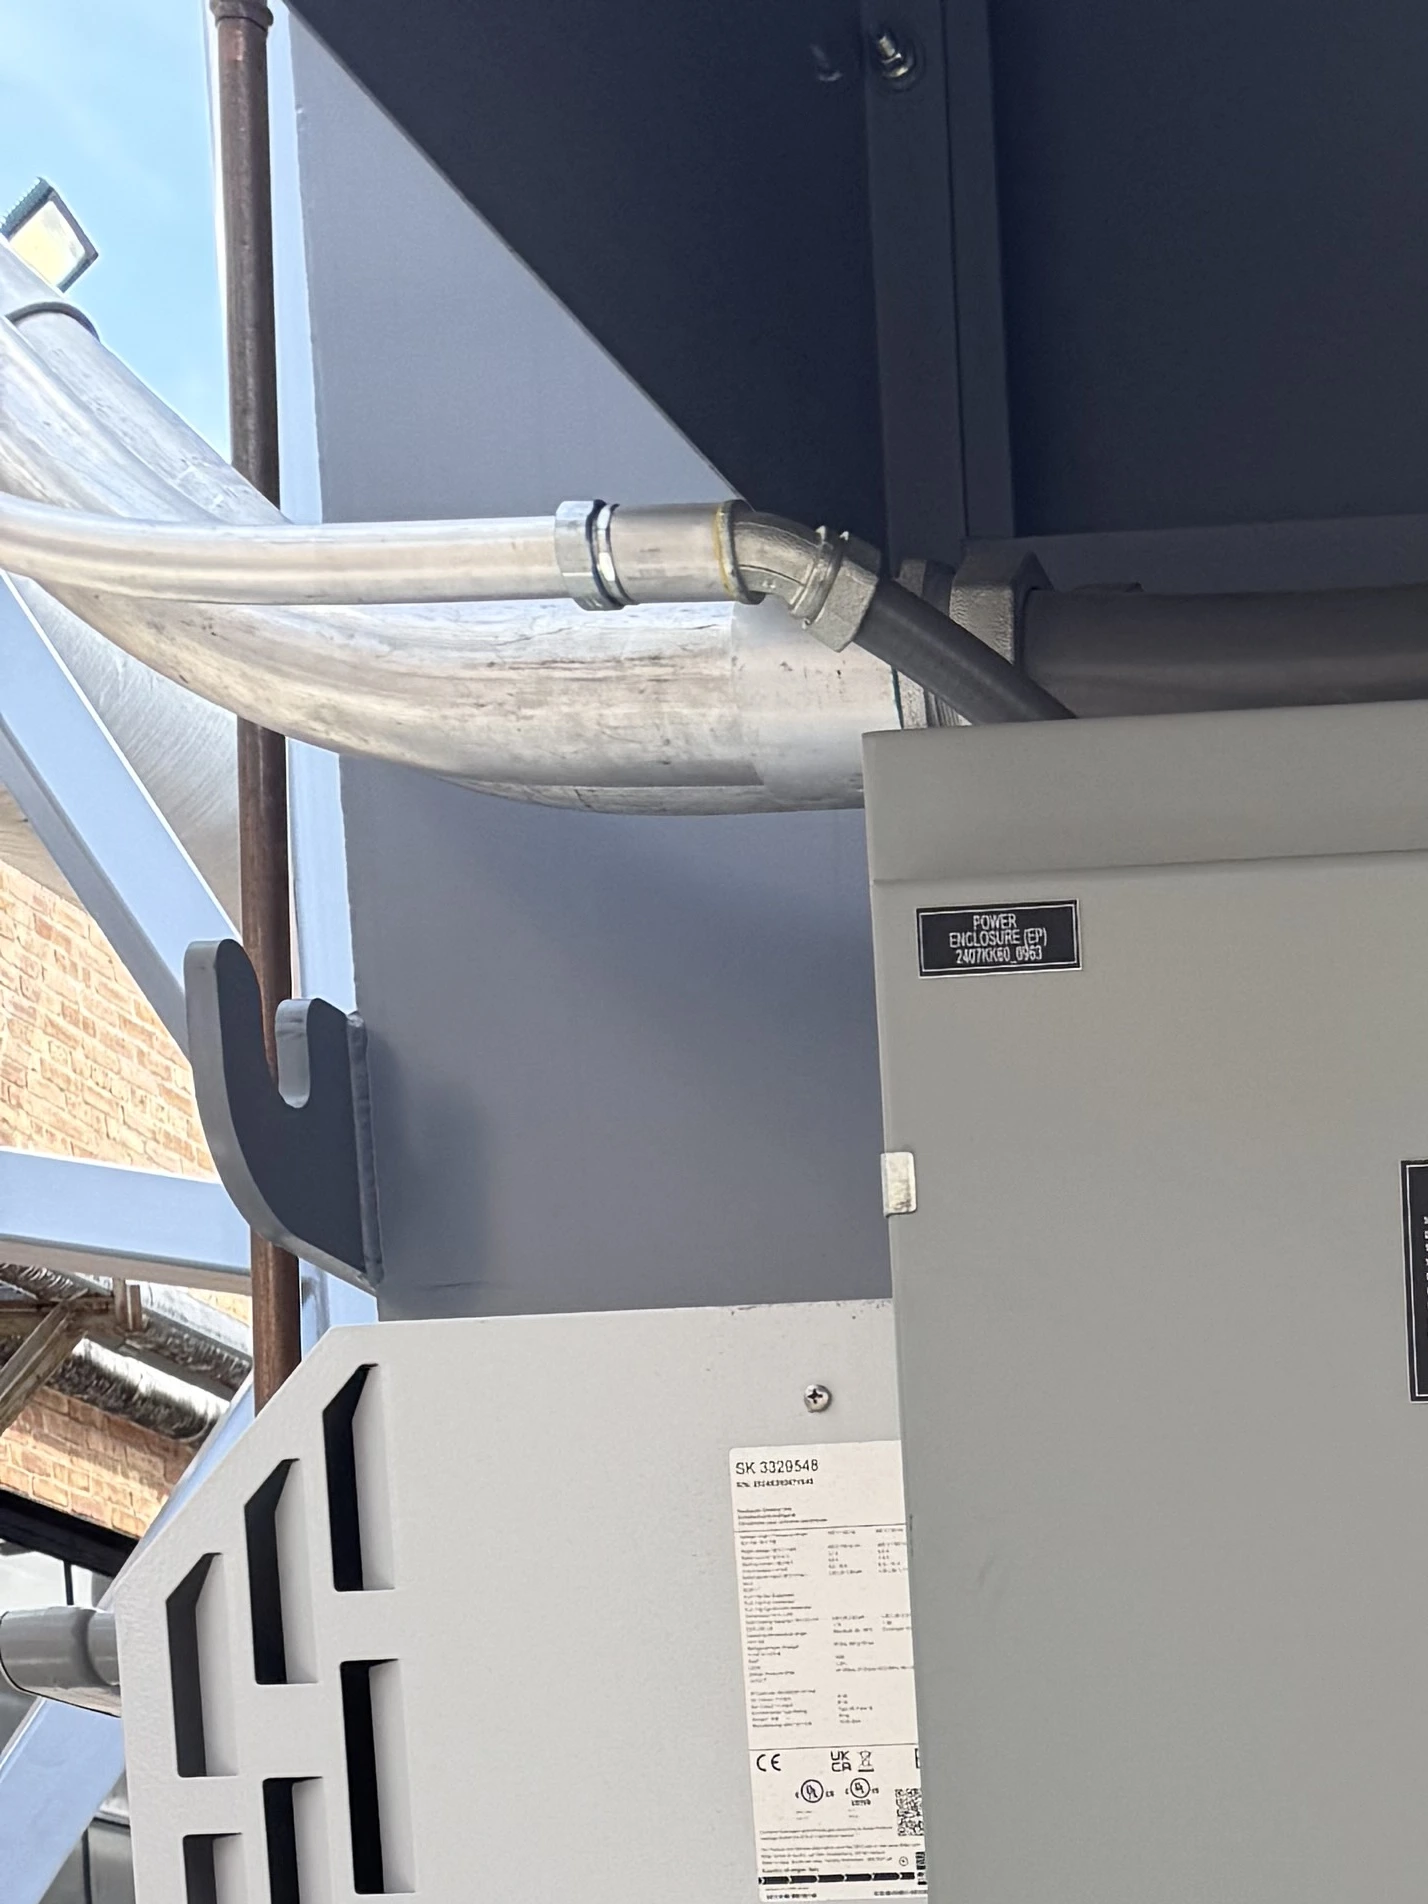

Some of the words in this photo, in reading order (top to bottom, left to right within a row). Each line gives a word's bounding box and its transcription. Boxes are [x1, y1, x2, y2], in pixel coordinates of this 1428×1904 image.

[973, 913, 1017, 930] POWER
[949, 929, 1021, 948] ENCLOSURE
[1024, 927, 1047, 949] (EP)
[735, 1461, 756, 1475] SK
[756, 1753, 782, 1772] CE
[830, 1751, 850, 1761] UK
[831, 1762, 852, 1772] CA
